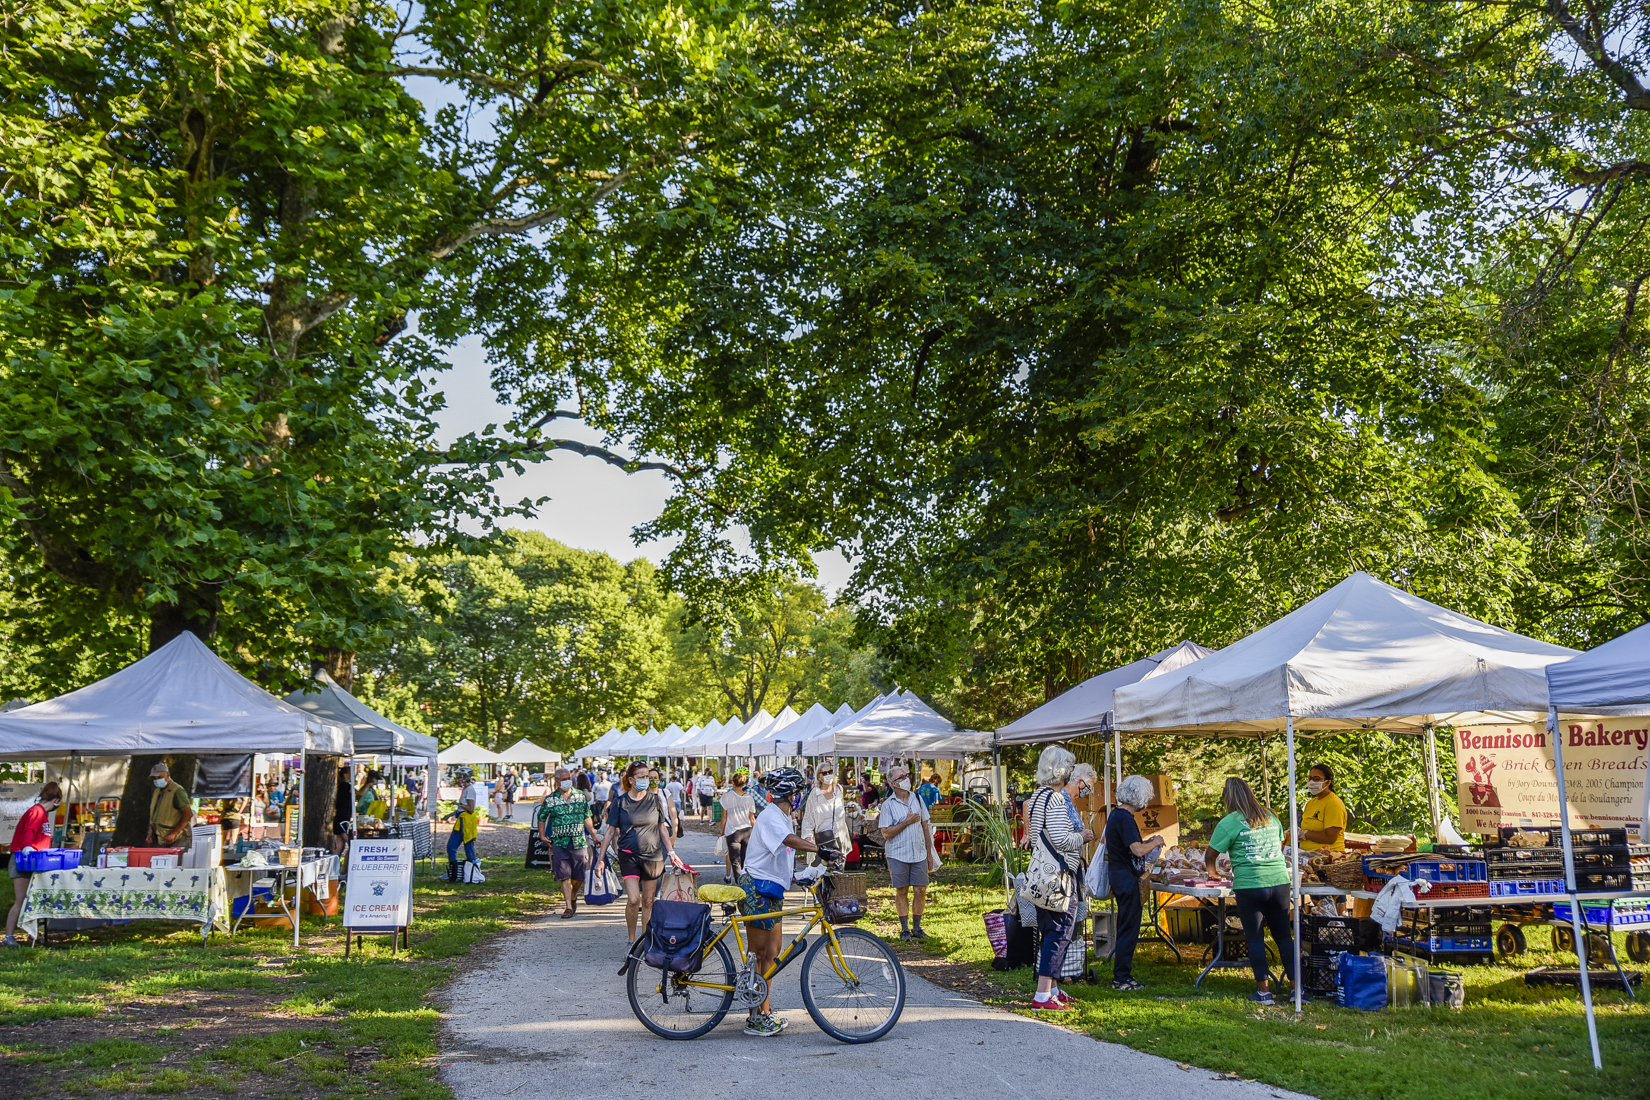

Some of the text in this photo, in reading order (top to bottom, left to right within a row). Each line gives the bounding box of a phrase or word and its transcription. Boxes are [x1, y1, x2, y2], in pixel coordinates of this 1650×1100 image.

[1568, 723, 1648, 750] Bakery
[1501, 758, 1543, 773] Brick
[1587, 756, 1649, 770] Breads
[1508, 779, 1515, 790] by
[1516, 780, 1530, 790] Jory
[1586, 779, 1602, 788] 2005
[1605, 777, 1643, 791] Champion
[1518, 792, 1536, 804] Coupe
[1537, 791, 1545, 801] du
[1571, 792, 1578, 802] de
[1580, 792, 1587, 802] la
[1588, 793, 1633, 807] Boulangerie
[1476, 819, 1487, 828] We
[1574, 814, 1644, 822] www.bennisonscakes.c
[351, 863, 409, 871] BLUEBERRIES
[352, 904, 399, 912] ICE CREAM
